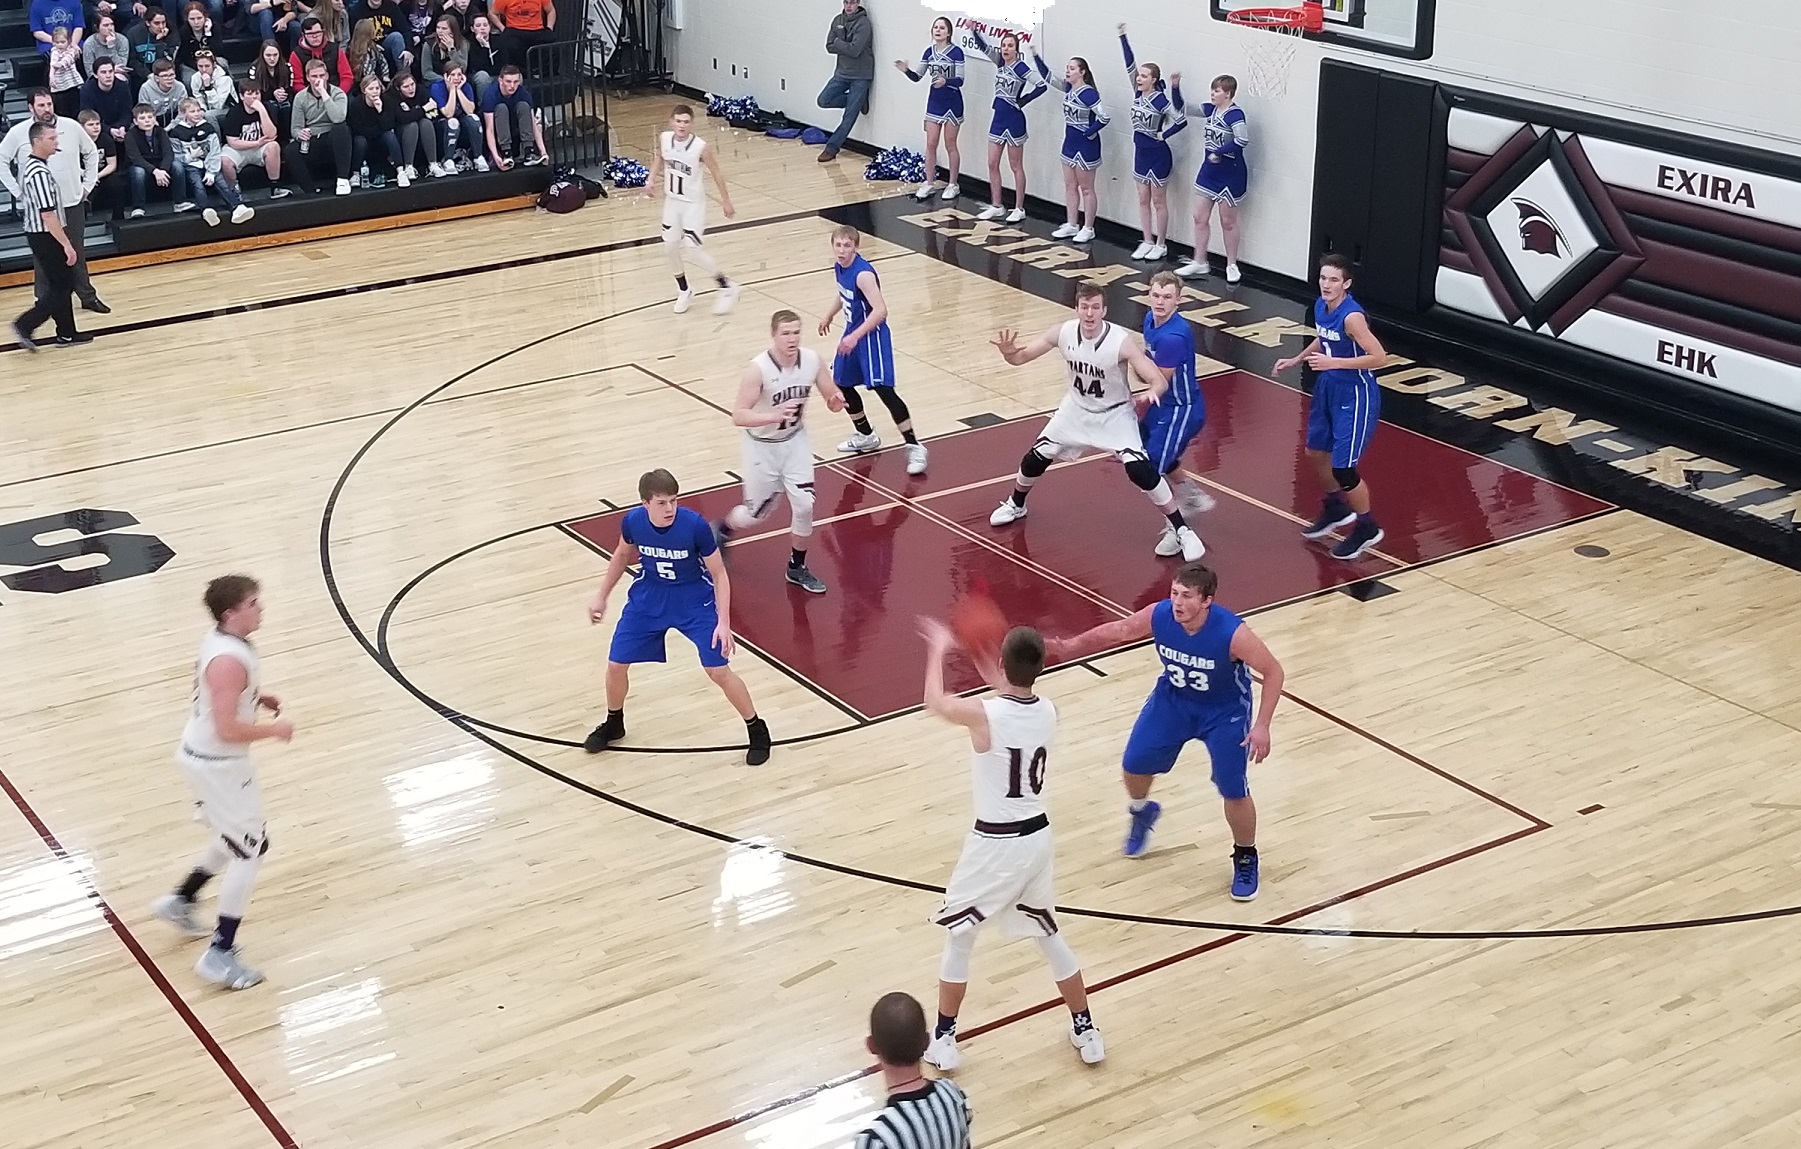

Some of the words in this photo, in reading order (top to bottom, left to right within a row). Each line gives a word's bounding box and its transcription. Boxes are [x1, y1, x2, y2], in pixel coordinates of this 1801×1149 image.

[669, 173, 685, 195] 11
[1656, 163, 1756, 210] EXIRA
[1656, 338, 1719, 379] EHK
[1073, 375, 1106, 398] 44
[638, 545, 689, 560] COUGARS
[655, 561, 677, 581] 5
[1159, 643, 1216, 670] COUGARS
[1166, 663, 1210, 692] 33
[1003, 746, 1048, 799] 10
